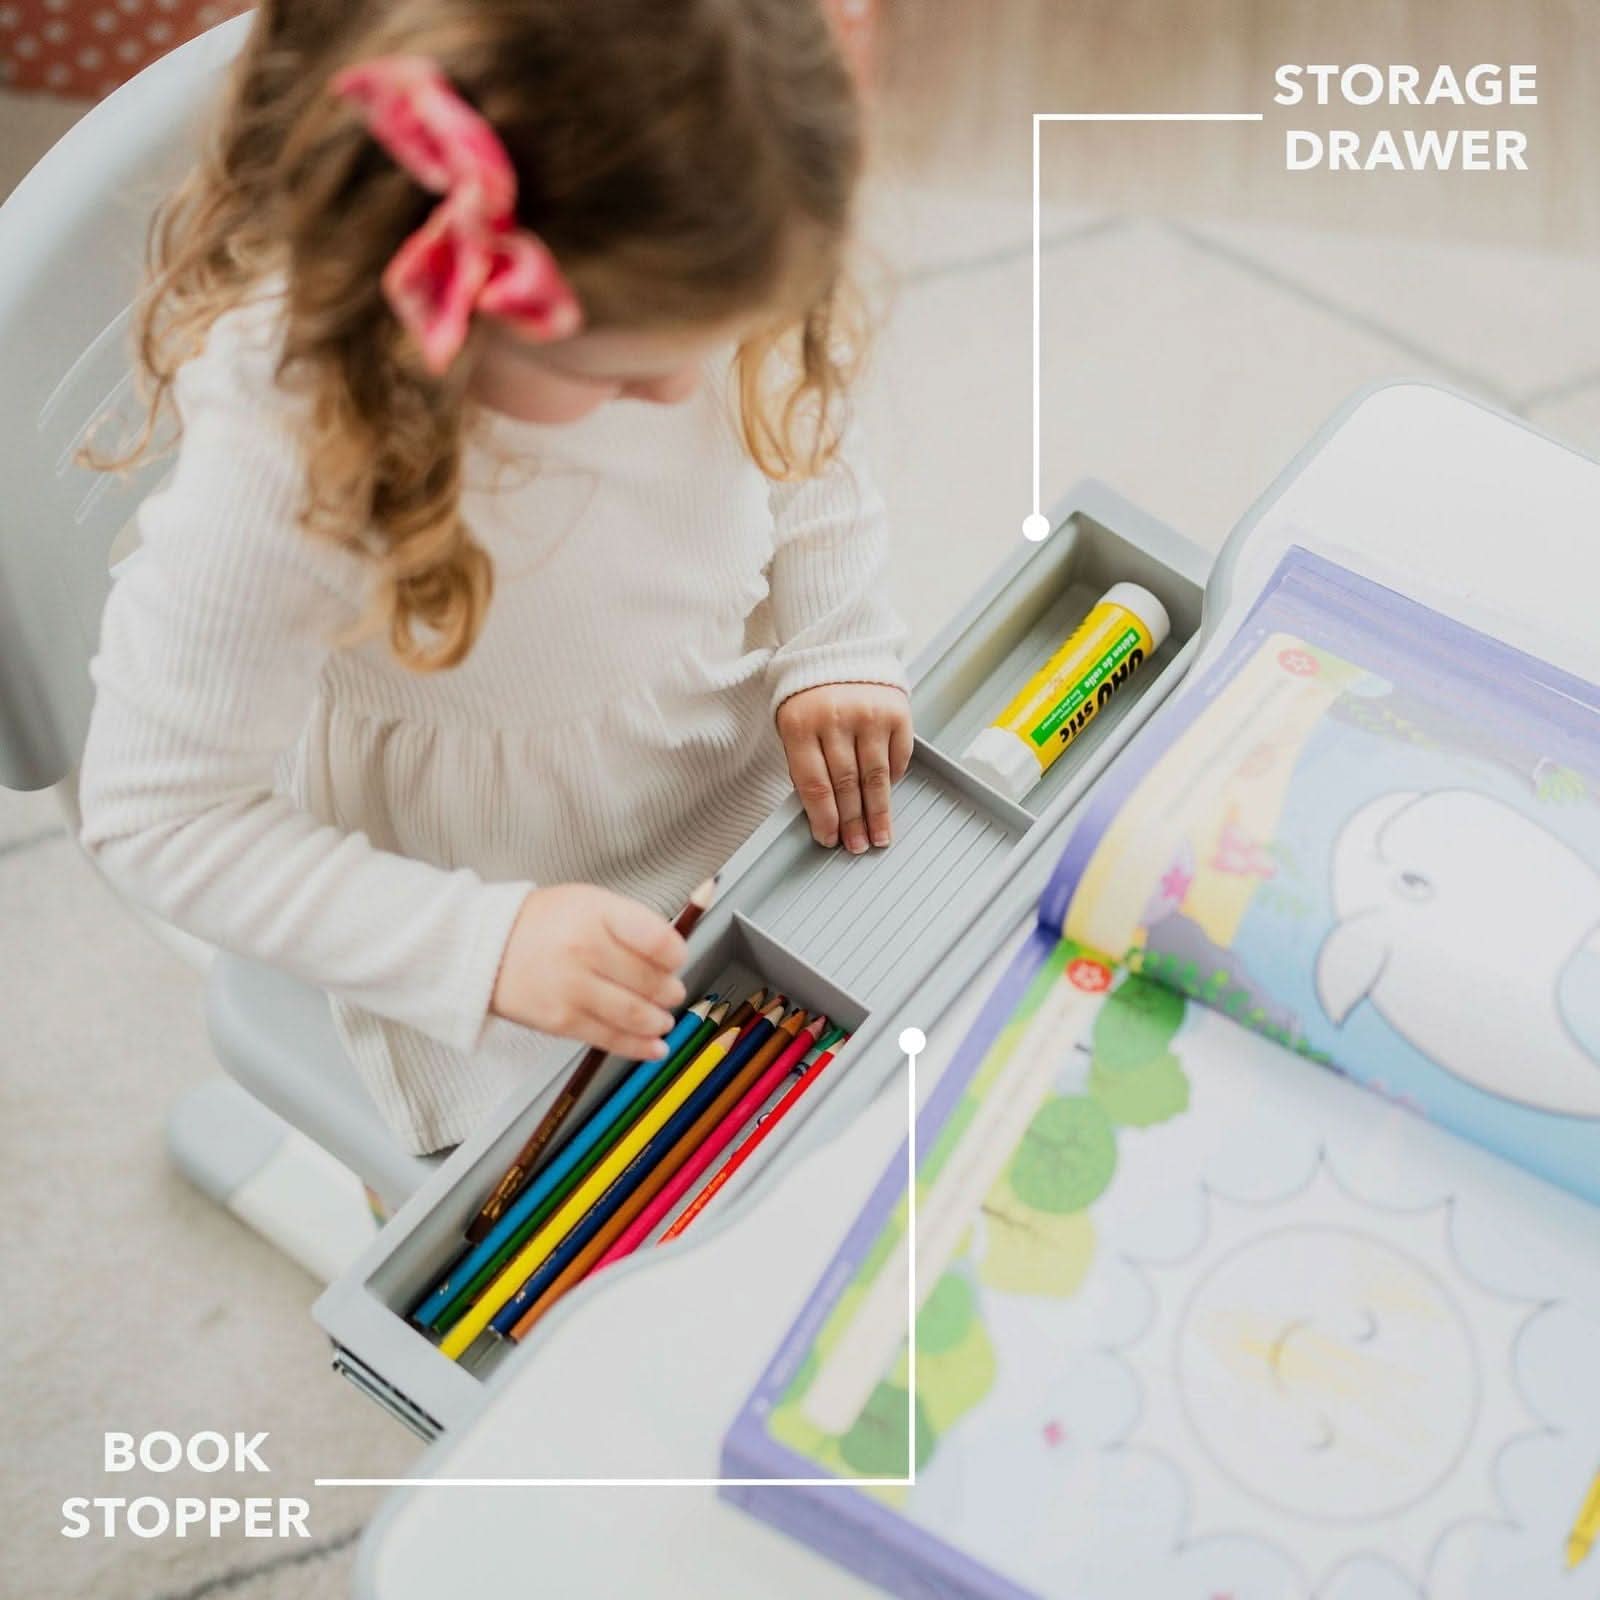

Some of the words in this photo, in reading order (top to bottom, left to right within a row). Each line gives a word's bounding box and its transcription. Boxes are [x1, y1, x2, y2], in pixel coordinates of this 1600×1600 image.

[1097, 648, 1144, 711] UHU
[1102, 655, 1115, 669] de
[1060, 701, 1094, 743] stic
